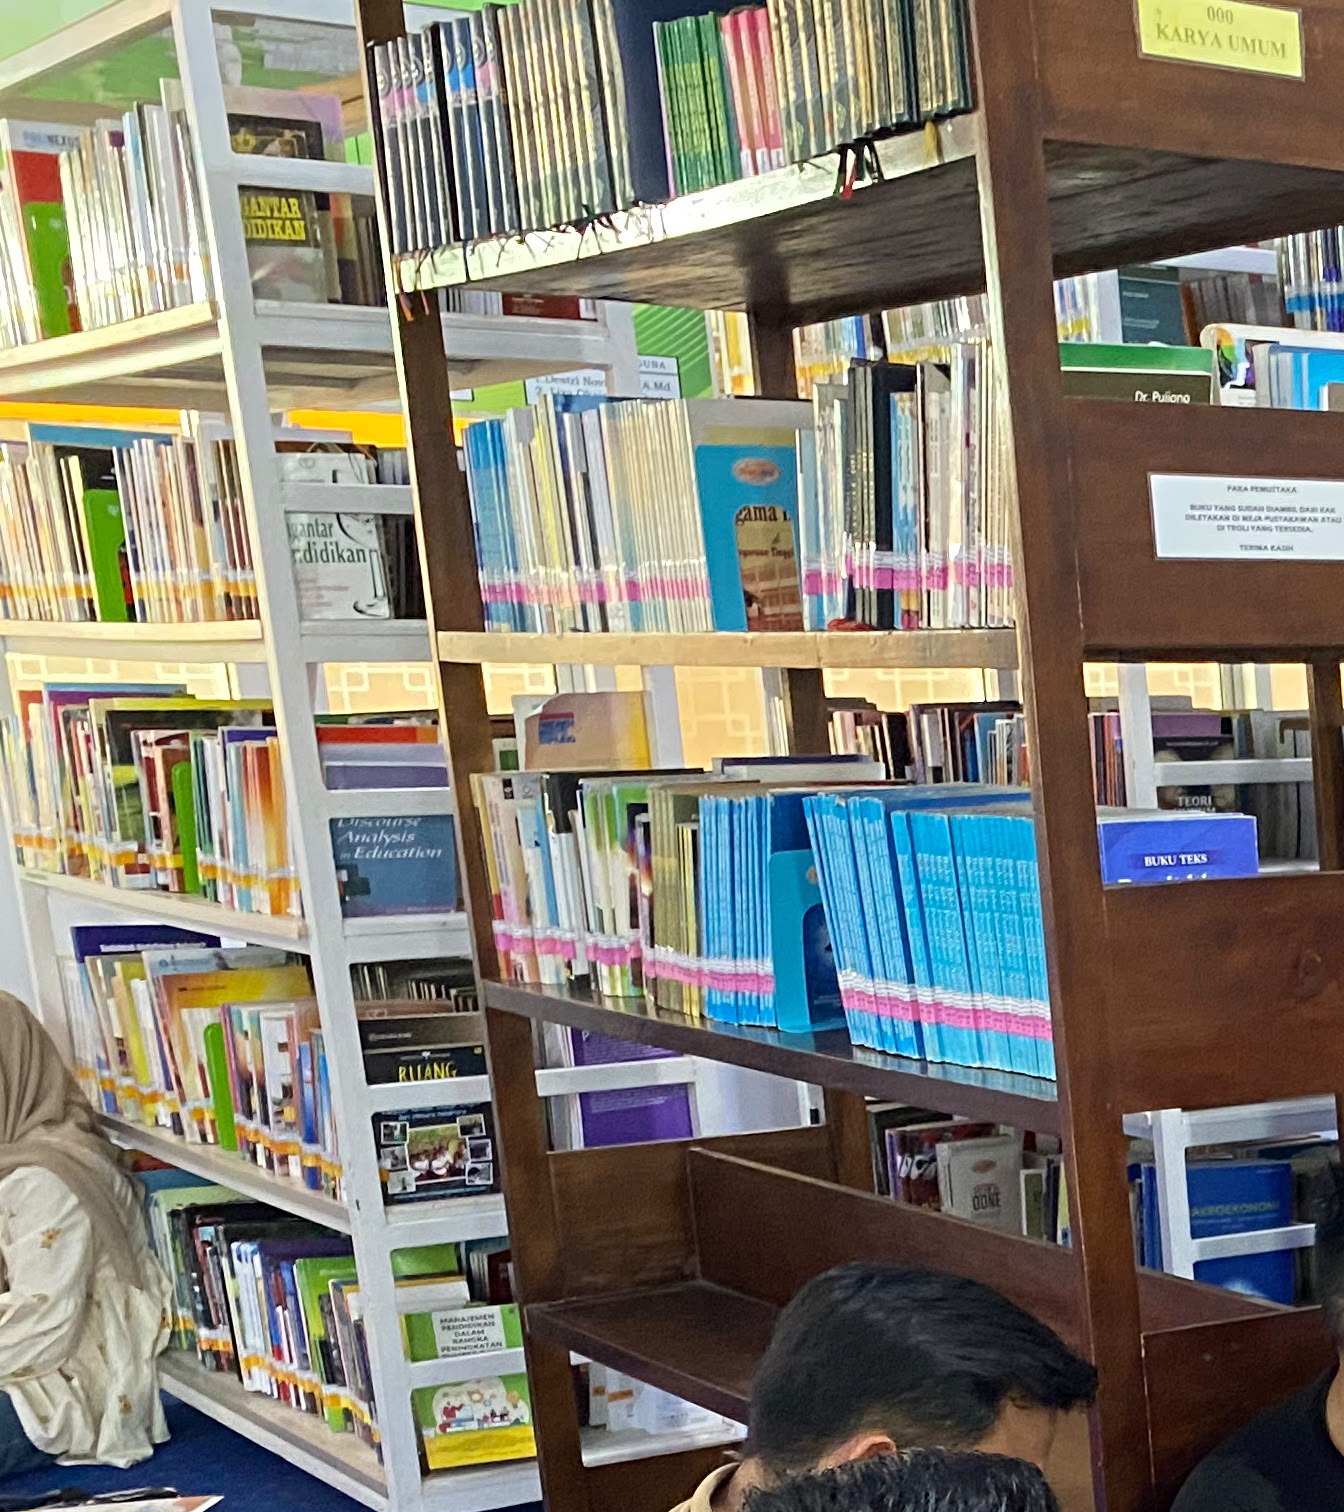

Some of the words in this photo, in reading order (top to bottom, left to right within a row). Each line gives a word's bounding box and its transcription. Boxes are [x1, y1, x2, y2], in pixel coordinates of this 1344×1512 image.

[1206, 5, 1234, 24] 000
[1155, 23, 1222, 48] KARYA
[1228, 35, 1286, 59] UMUM
[1178, 795, 1212, 807] TEORI
[337, 829, 416, 847] Analysis
[353, 845, 442, 859] Education
[1144, 855, 1177, 867] BUKU
[1179, 853, 1208, 865] TEKS
[398, 1060, 458, 1083] RUANG
[454, 1329, 485, 1338] DALAM
